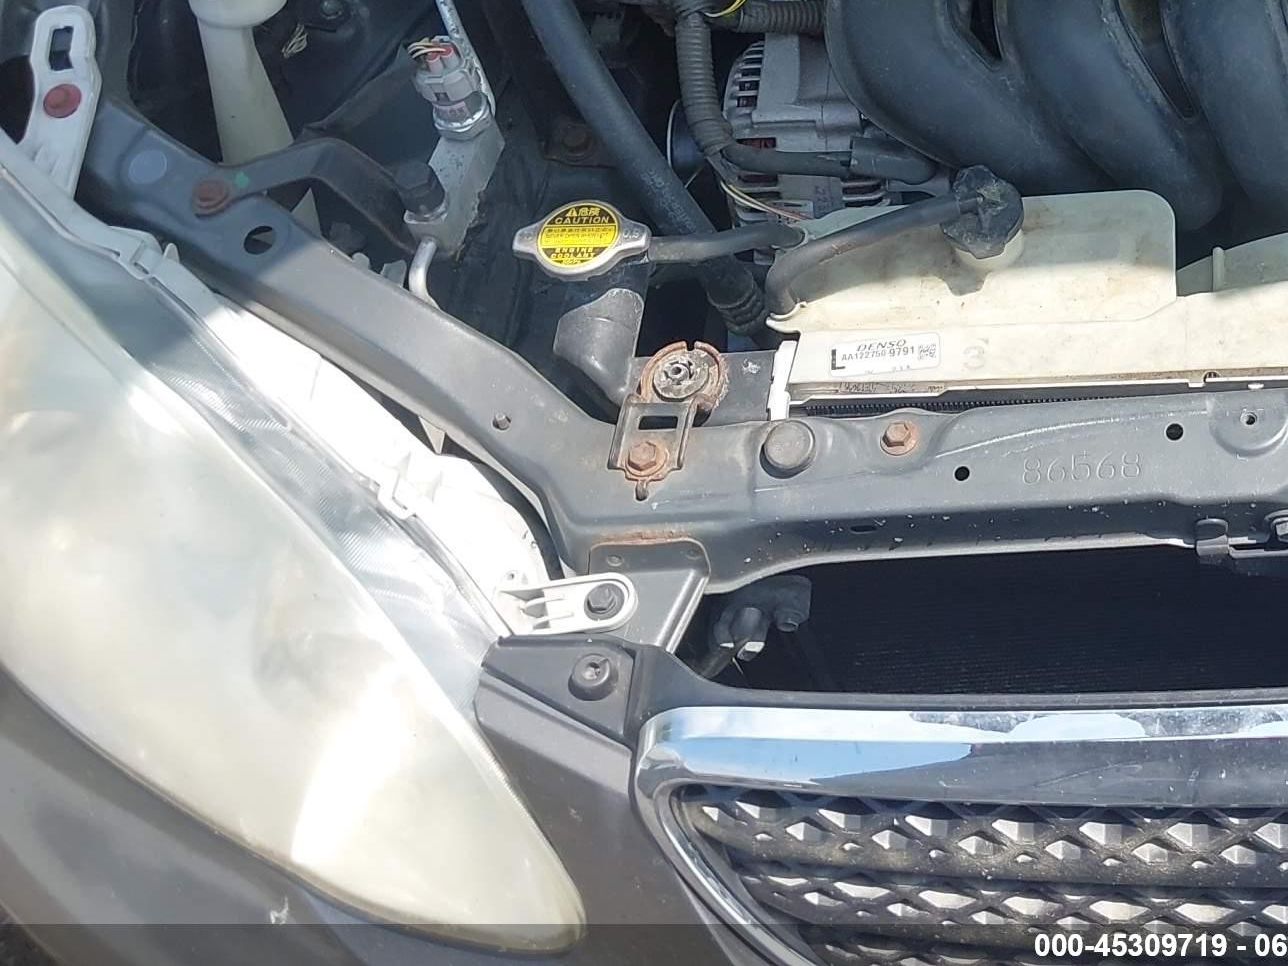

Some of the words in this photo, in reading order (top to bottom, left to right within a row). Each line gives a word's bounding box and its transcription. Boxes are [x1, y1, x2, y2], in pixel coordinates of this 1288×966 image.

[554, 216, 610, 225] CAUTION
[857, 338, 907, 352] DENSO
[1022, 450, 1142, 484] 86568
